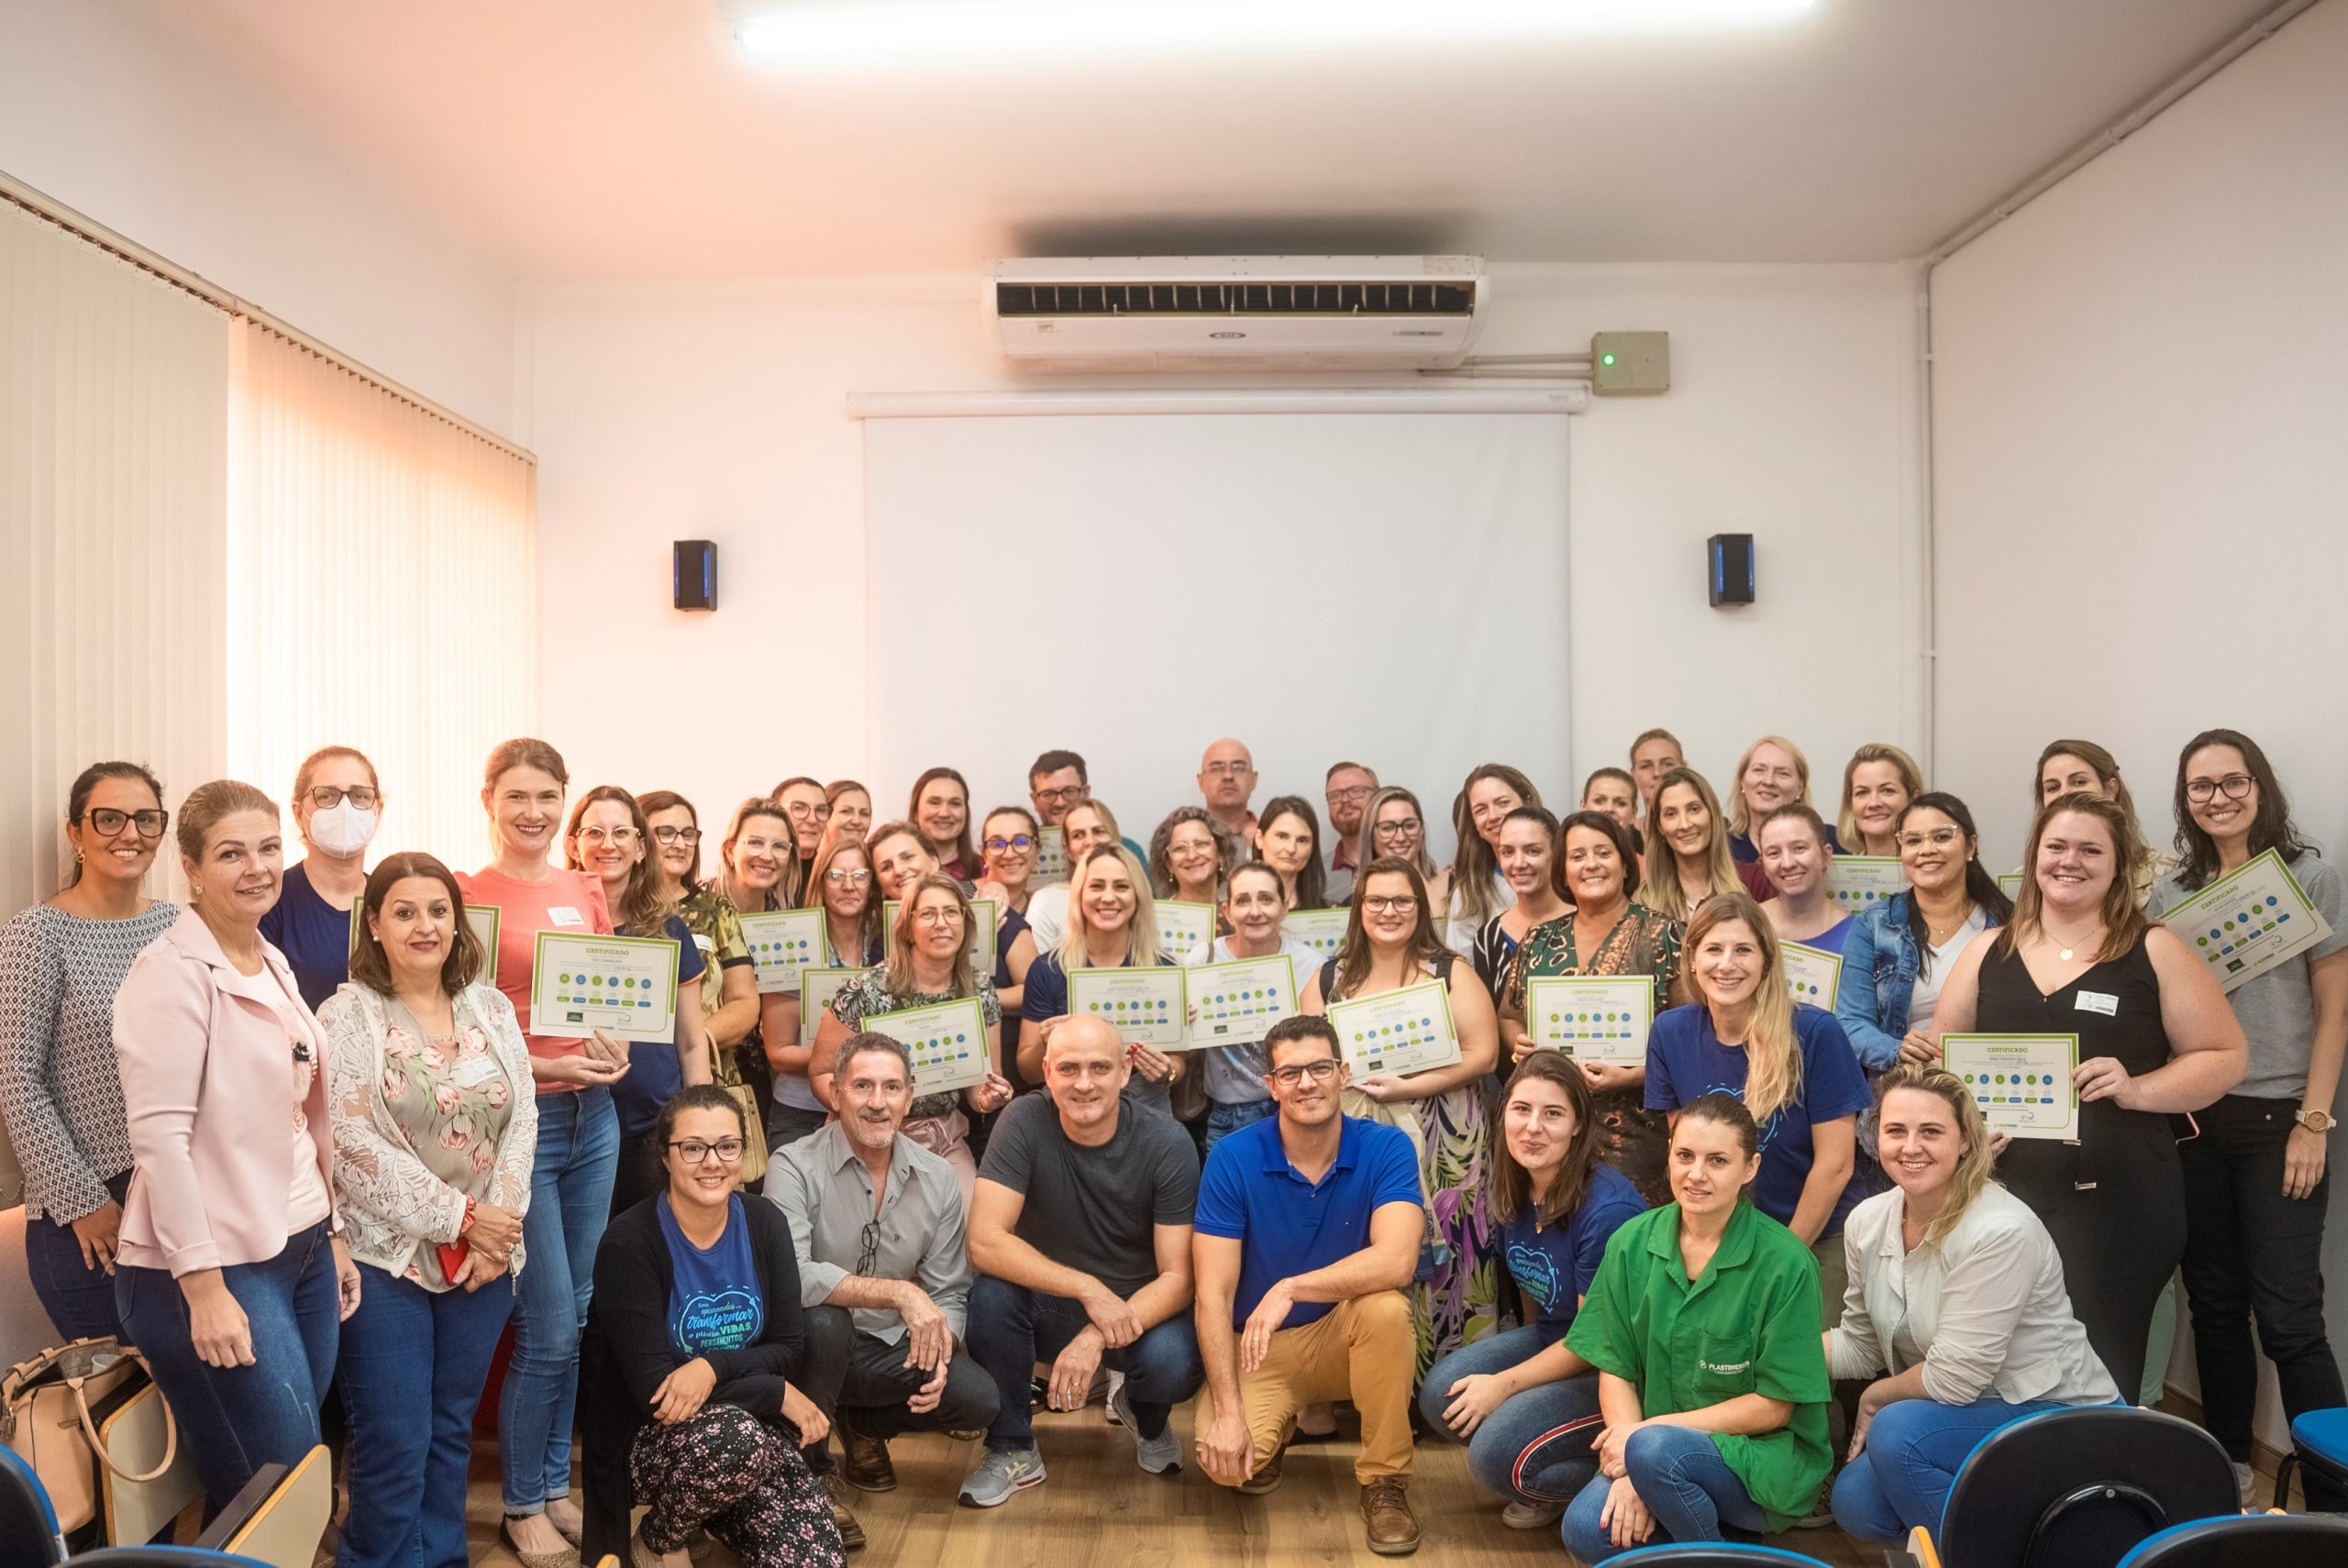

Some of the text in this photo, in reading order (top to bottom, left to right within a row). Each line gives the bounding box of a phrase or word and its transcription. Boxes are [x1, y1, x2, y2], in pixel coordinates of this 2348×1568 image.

[2200, 885, 2239, 910] CERTIFICADO
[586, 947, 630, 956] CERTIFICADO
[687, 1308, 754, 1330] transformar
